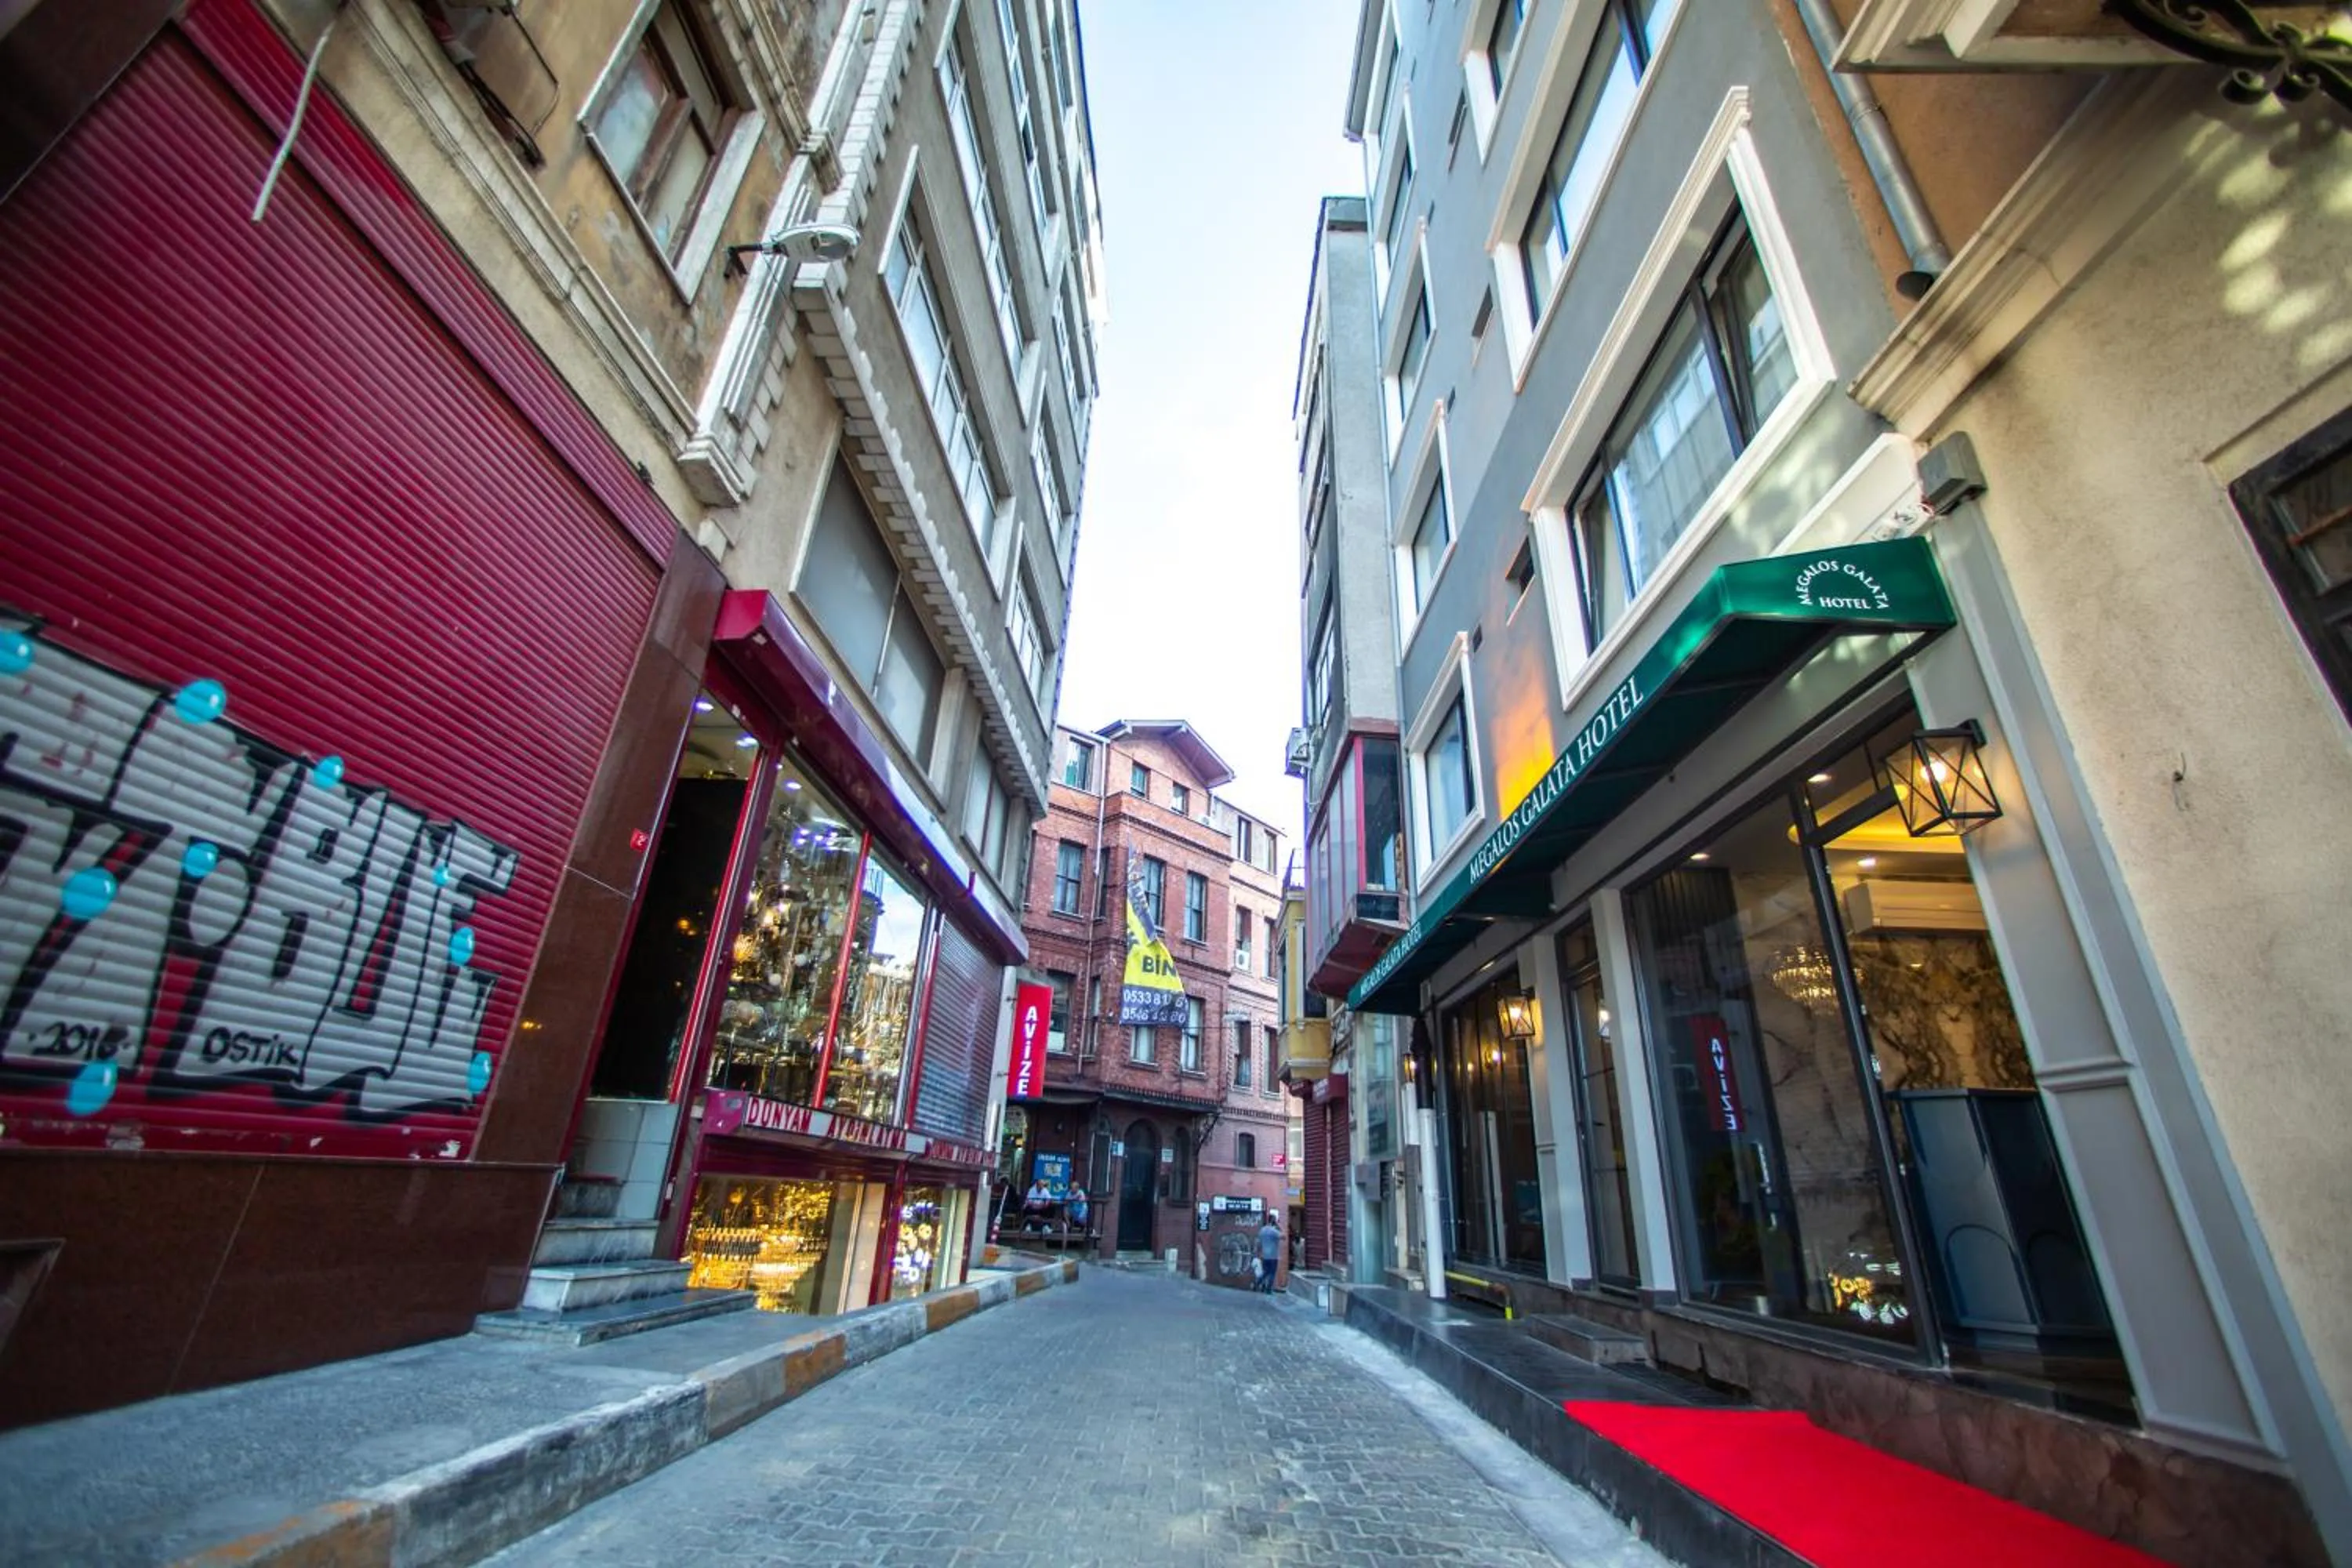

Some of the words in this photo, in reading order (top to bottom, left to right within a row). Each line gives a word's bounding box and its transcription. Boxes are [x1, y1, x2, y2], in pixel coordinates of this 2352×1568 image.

[1795, 560, 1840, 606] MEGALOS
[1843, 564, 1890, 609] GALATA
[1818, 597, 1871, 609] HOTEL
[1470, 811, 1520, 884] MEGALOS
[1519, 758, 1577, 826] GALATA
[1577, 674, 1645, 766] HOTEL
[1123, 989, 1151, 1004] 0533
